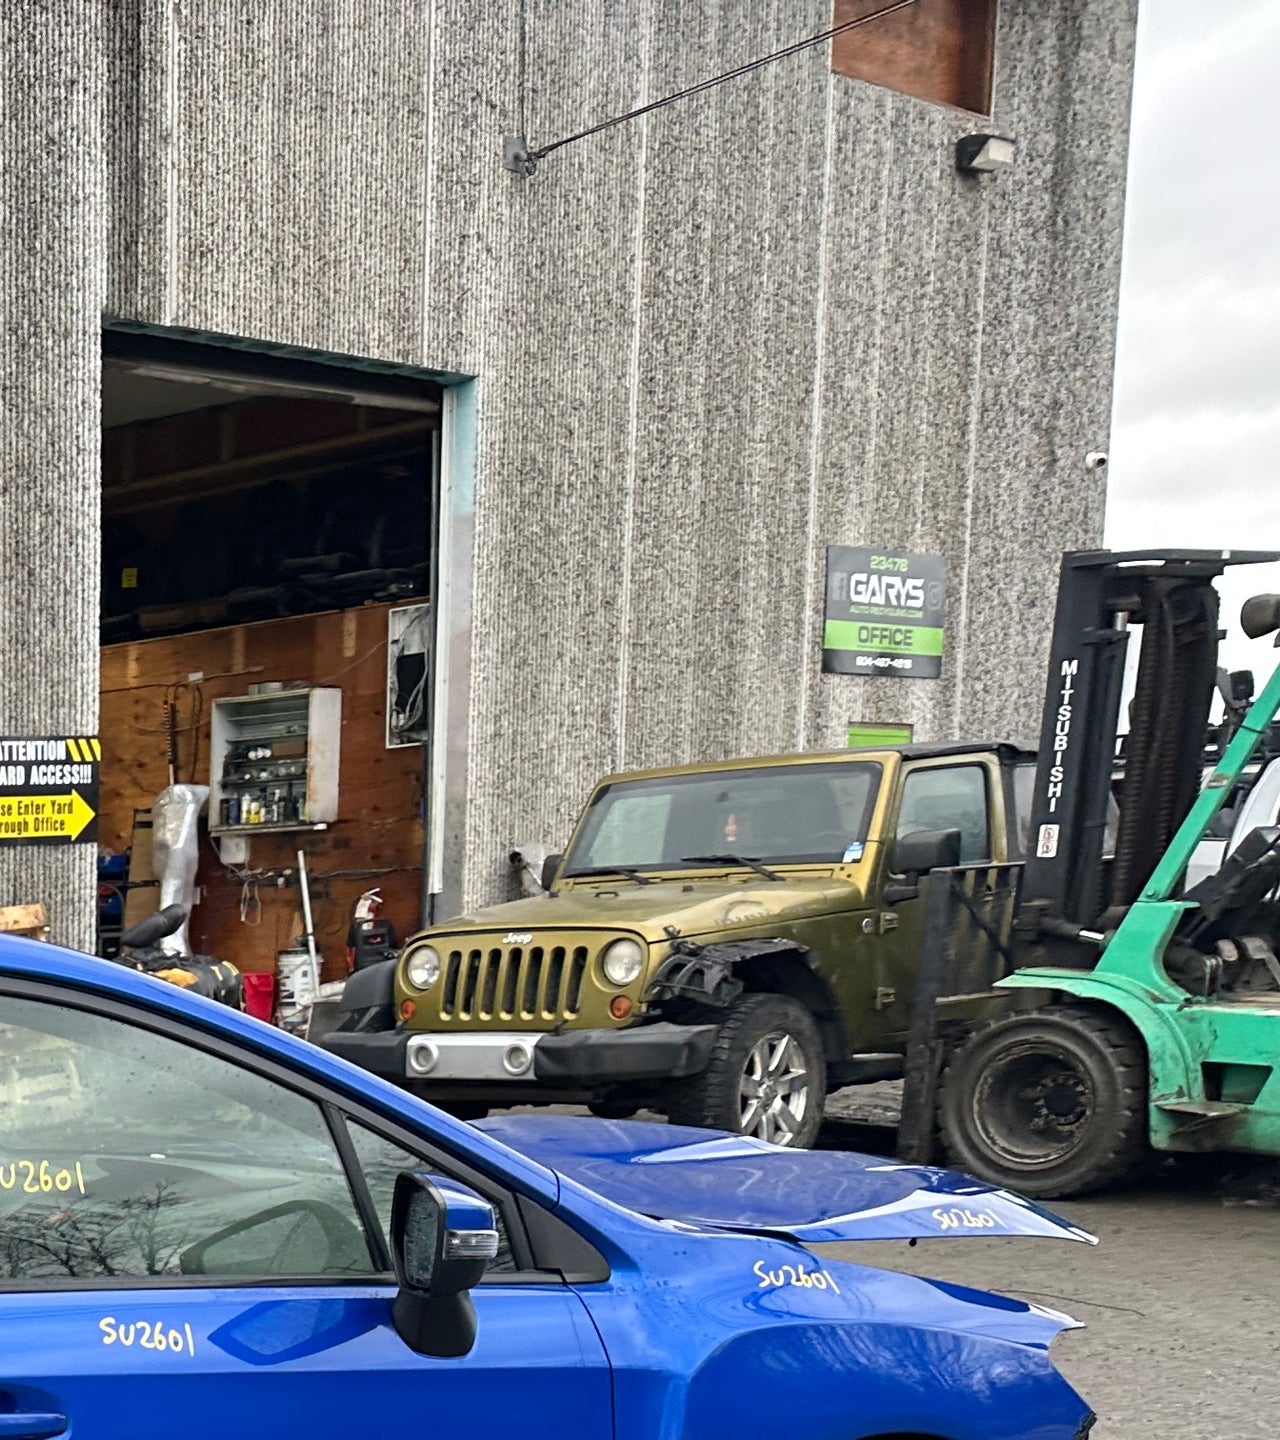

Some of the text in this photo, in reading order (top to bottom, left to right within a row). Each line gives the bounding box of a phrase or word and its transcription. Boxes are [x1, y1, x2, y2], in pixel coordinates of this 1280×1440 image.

[850, 573, 925, 608] GARYS
[857, 626, 914, 647] OFFICE
[1047, 660, 1078, 813] MITSUBISHI
[30, 764, 92, 786] ACCESS!!!
[17, 800, 46, 816] Enter
[51, 799, 73, 815] Yard
[33, 818, 66, 833] Office
[502, 932, 533, 945] Jeep
[753, 1260, 841, 1294] SU2601
[98, 1316, 195, 1357] SU2601
